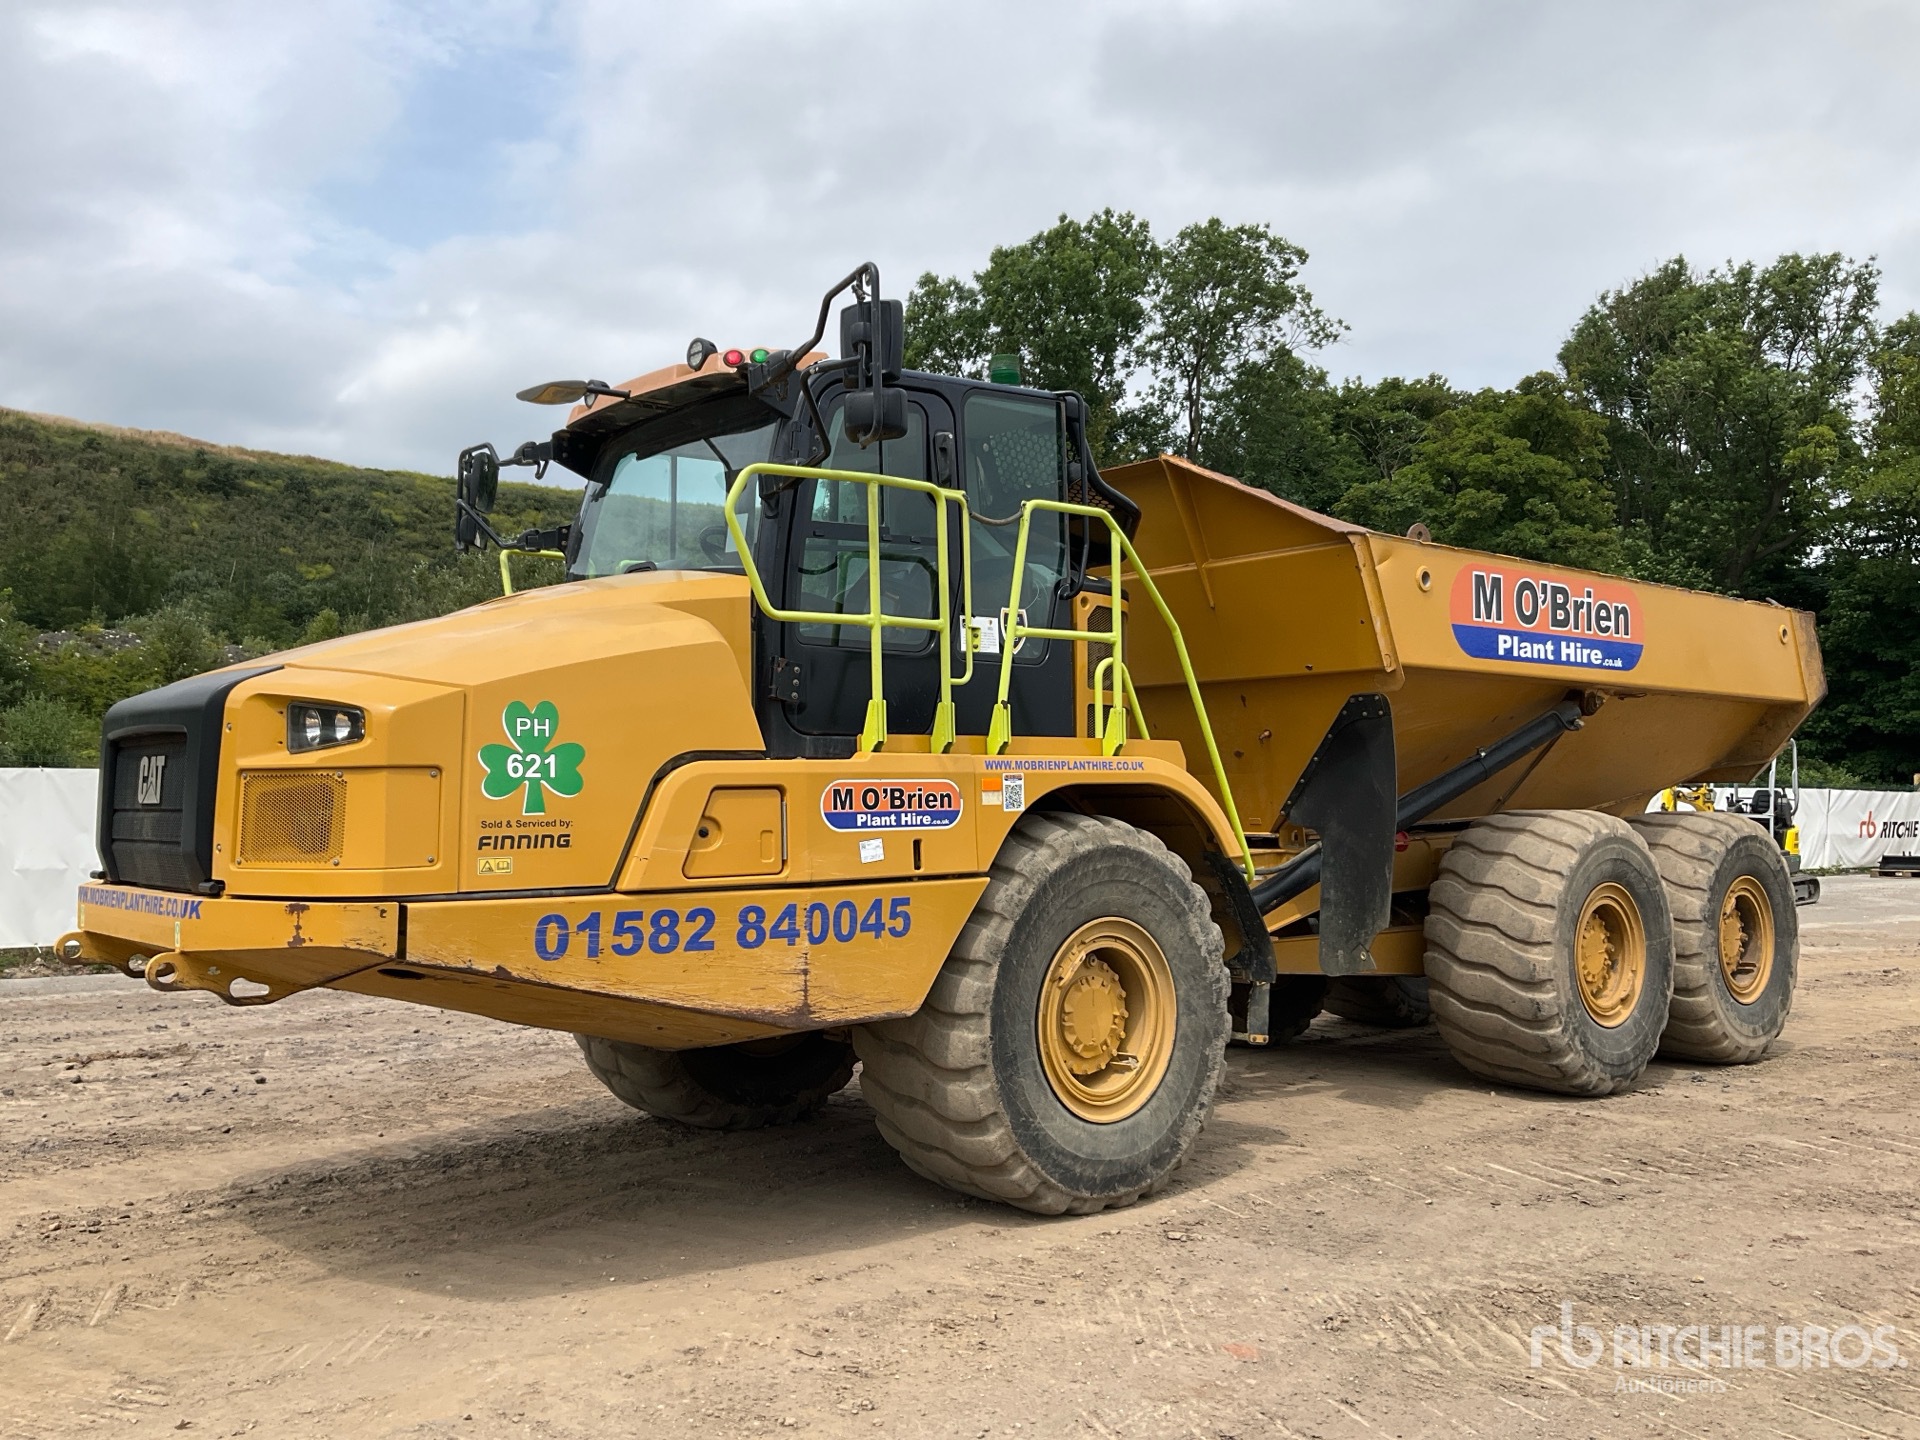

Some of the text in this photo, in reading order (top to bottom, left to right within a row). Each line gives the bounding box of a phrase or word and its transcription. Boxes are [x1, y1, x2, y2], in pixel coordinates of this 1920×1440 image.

[1472, 571, 1631, 638] M O'Brien
[1497, 634, 1554, 661] Plant
[516, 717, 550, 738] PH
[506, 753, 556, 778] 621
[984, 760, 1145, 771] WWW.MOBRIENPLANTHIRE.CO.UK
[138, 755, 165, 804] CAT
[831, 786, 954, 811] M O'Brien
[480, 818, 574, 830] Sold & Serviced by:
[856, 812, 897, 827] Plant
[1880, 820, 1920, 839] RITCHIE
[477, 833, 572, 850] FINNING
[534, 896, 912, 962] 01582 840045
